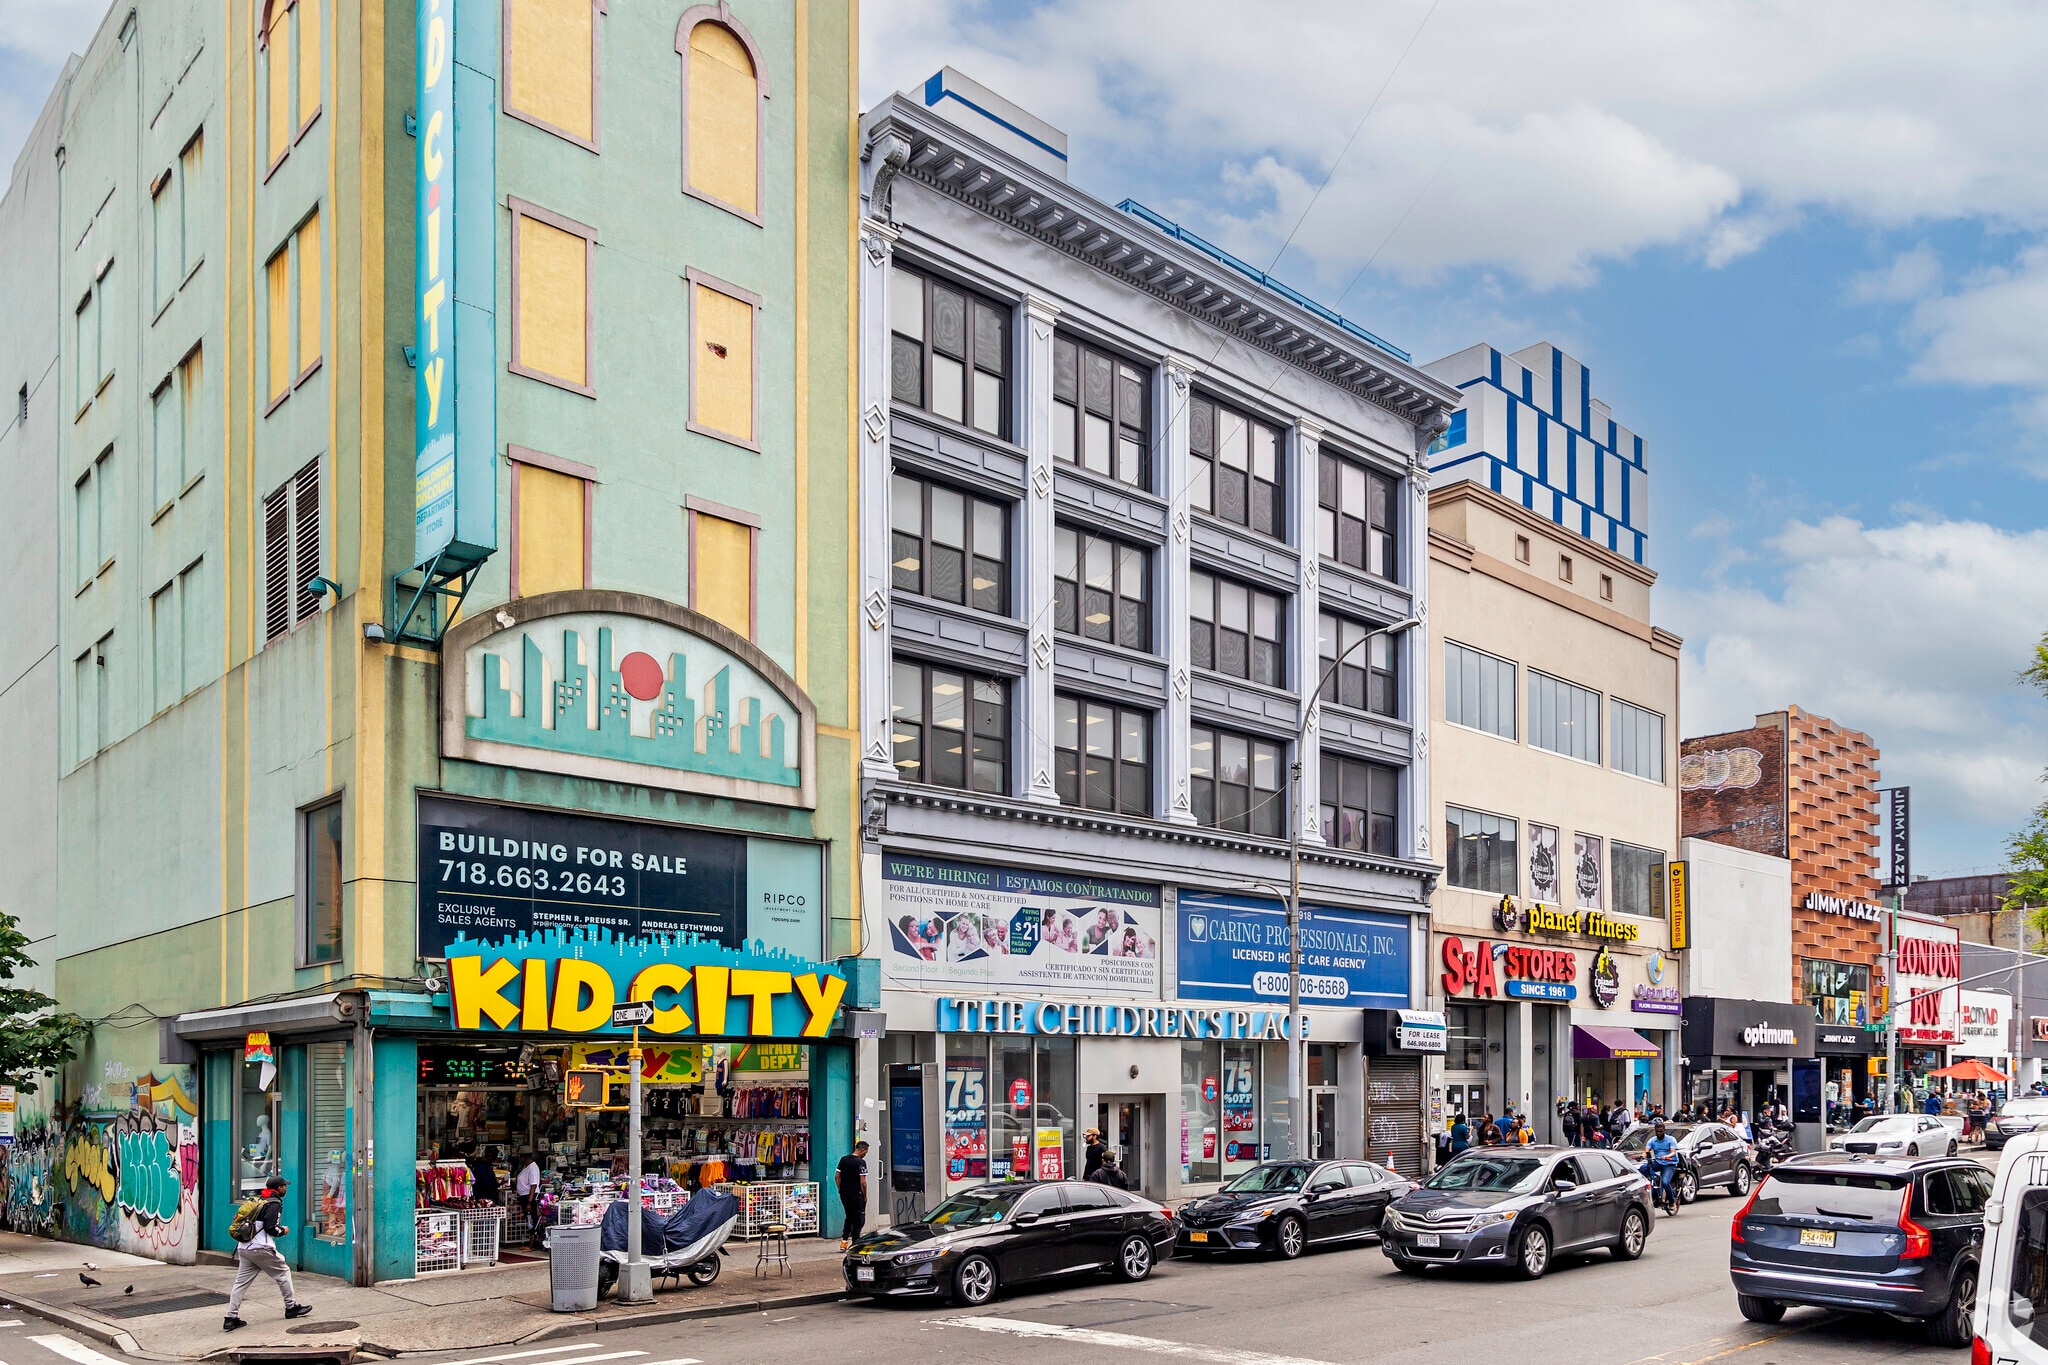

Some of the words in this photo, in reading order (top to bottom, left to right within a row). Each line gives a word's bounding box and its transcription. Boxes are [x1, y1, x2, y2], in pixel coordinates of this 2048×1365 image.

[421, 109, 446, 430] CITY
[416, 474, 454, 508] DISCOUNT
[416, 494, 454, 525] DEPARTMENT
[426, 517, 444, 535] STORE
[1895, 790, 1905, 841] JIMMY
[439, 831, 568, 863] BUILDING
[576, 846, 624, 869] FOR
[631, 852, 687, 875] SALE
[890, 862, 934, 879] WE'RE
[938, 868, 990, 885] HIRING!
[1895, 843, 1905, 885] JAZZ
[438, 859, 626, 897] 718.663.2643
[889, 884, 901, 892] FOR
[905, 885, 921, 894] ALL
[921, 887, 960, 899] CERTIFIED
[961, 891, 967, 899] &
[969, 892, 1027, 905] NON-CERTIFIED
[1006, 876, 1062, 894] ESTAMOS
[1066, 882, 1152, 903] CONTRATANDO!
[1672, 878, 1682, 908] planet
[764, 893, 806, 906] RIPCO
[889, 893, 934, 905] POSITIONS
[935, 897, 944, 905] IN
[945, 898, 969, 908] HOME
[970, 901, 991, 910] CARE
[1806, 892, 1849, 916] JIMMY
[1848, 902, 1881, 922] JAZZ
[438, 903, 496, 916] EXCLUSIVE
[533, 912, 572, 922] STEPHEN
[573, 915, 583, 923] R.
[584, 916, 616, 926] PREUSS
[618, 918, 631, 926] SR.
[438, 914, 471, 925] SALES
[475, 916, 516, 928] AGENTS
[641, 920, 678, 930] ANDREAS
[680, 923, 724, 933] EFTHYMIOU
[771, 916, 801, 924] ripcony.com
[1528, 903, 1582, 934] planet
[1588, 911, 1639, 941] fitness
[1674, 910, 1682, 943] fitness
[1209, 919, 1262, 944] CARING
[1265, 925, 1370, 957] PROESSIONALS,
[1373, 936, 1396, 956] INC.
[1101, 959, 1139, 968] POSICIONES
[1140, 961, 1154, 969] CON
[1232, 948, 1275, 962] LICENSED
[1278, 952, 1305, 965] HOE
[1308, 954, 1331, 967] CARE
[1332, 957, 1366, 969] AGENCY
[1897, 935, 1959, 978] LONDON
[892, 963, 919, 972] Second
[920, 964, 938, 973] Floor
[948, 967, 978, 978] Segundo
[979, 968, 995, 977] Piso
[1018, 970, 1061, 979] ASSISTENTE
[1062, 972, 1072, 980] DE
[1045, 963, 1092, 973] CERTIFICADO
[1099, 966, 1110, 974] SIN
[1111, 967, 1154, 977] CERTIFICADO
[1441, 936, 1498, 997] S&A
[1504, 946, 1576, 981] STORES
[1257, 975, 1345, 996] 1-80006-6568
[1520, 984, 1546, 996] SINCE
[1548, 986, 1566, 997] 1961
[1598, 977, 1614, 987] planet
[447, 955, 615, 1031] KID
[629, 963, 848, 1037] CITY
[616, 1010, 628, 1020] ONE
[634, 1008, 649, 1018] WAY
[1910, 987, 1943, 1025] BOY
[950, 999, 1024, 1033] THE
[1035, 1001, 1222, 1039] CHILDREN'S
[1230, 1011, 1310, 1041] PLACE
[1408, 1030, 1421, 1038] FOR
[1423, 1031, 1440, 1039] LEASE
[760, 1055, 800, 1070] DEPT.
[1224, 1061, 1252, 1093] 75
[945, 1071, 984, 1110] 75
[1224, 1093, 1252, 1104] %OFF
[945, 1109, 985, 1122] %OFF
[1227, 1144, 1239, 1155] 50
[950, 1158, 966, 1172] 50
[1042, 1159, 1059, 1173] 75
[1785, 1216, 1850, 1226] VOLVO
